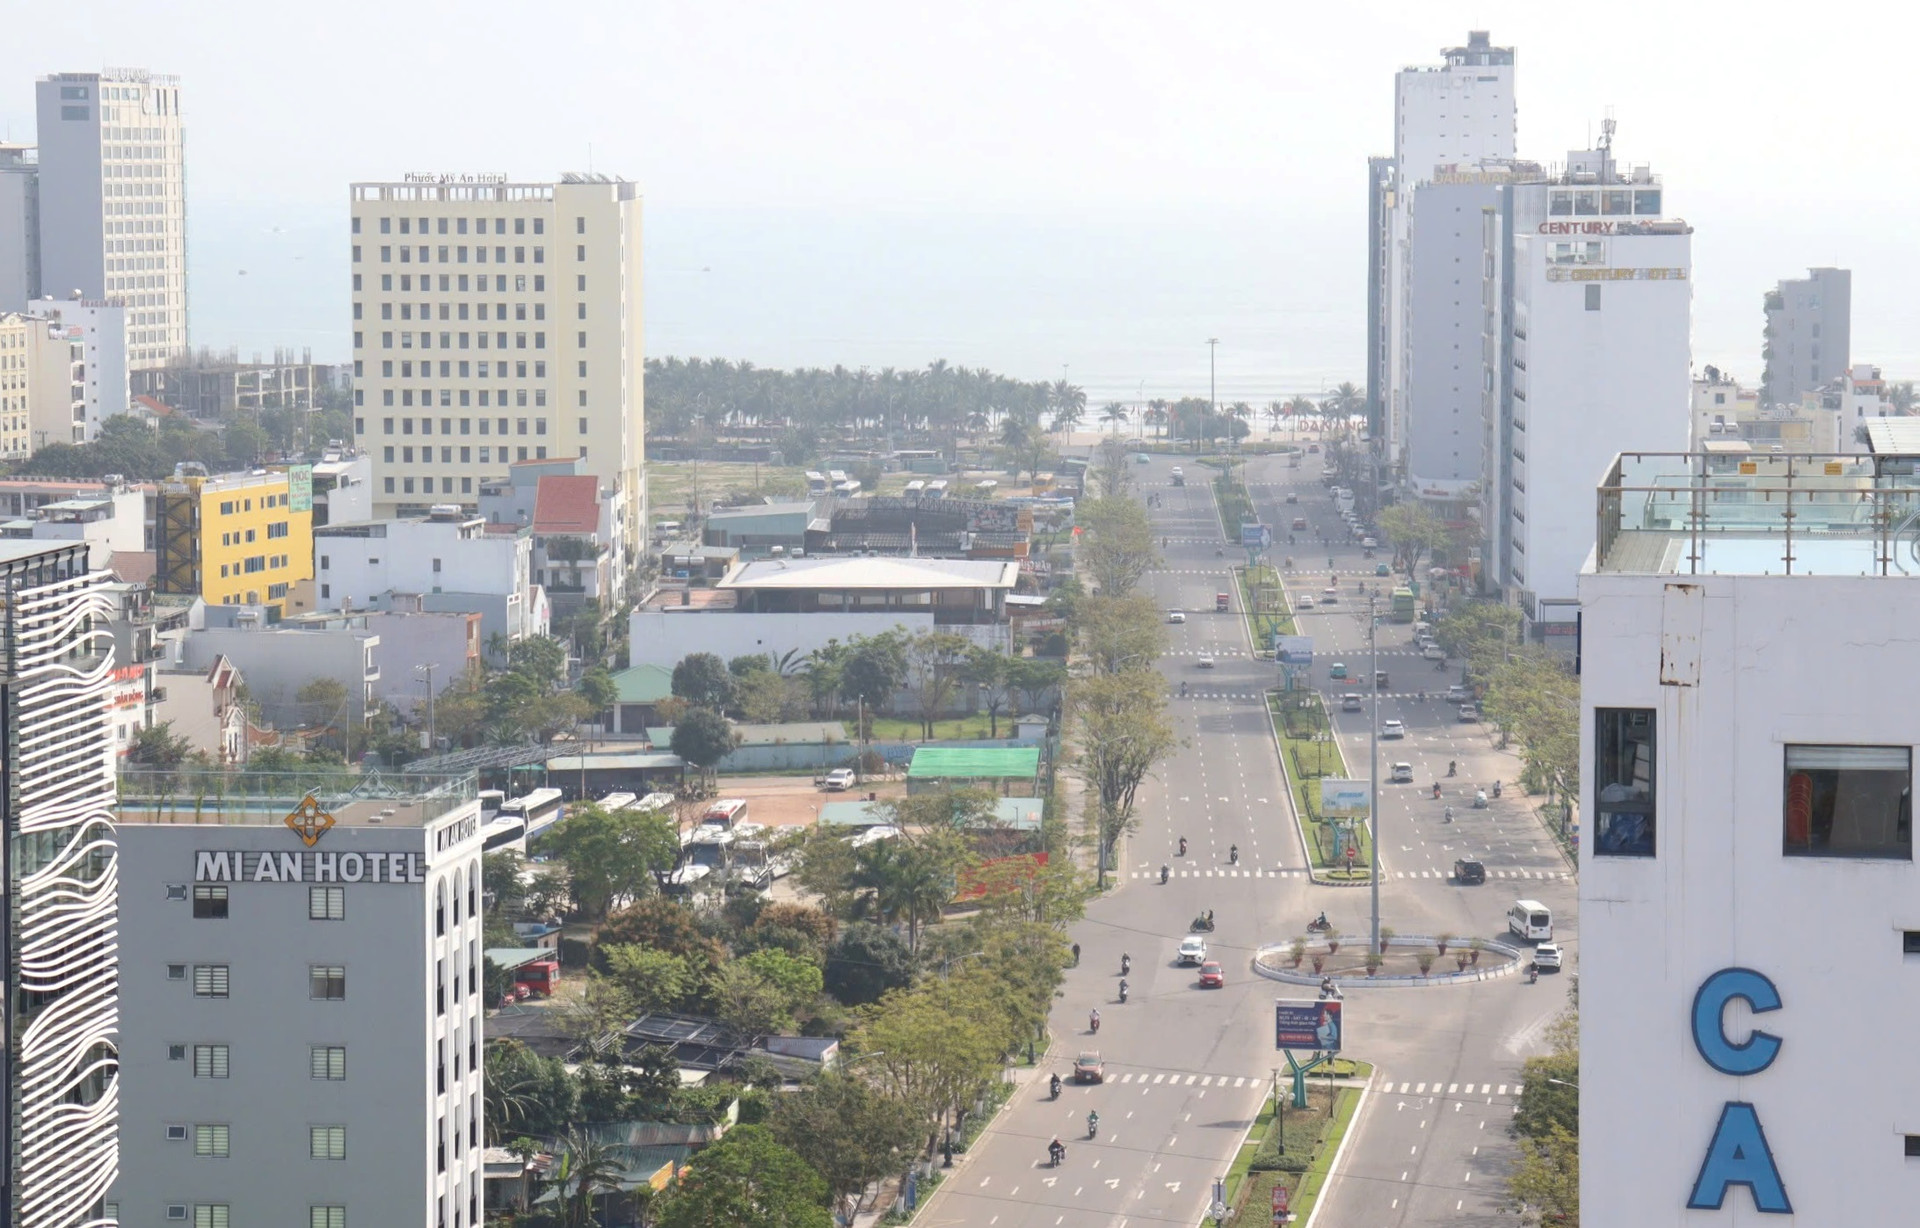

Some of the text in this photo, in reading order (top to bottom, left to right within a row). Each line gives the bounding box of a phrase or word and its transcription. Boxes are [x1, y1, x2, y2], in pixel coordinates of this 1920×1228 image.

[1538, 221, 1614, 235] CENTURY
[195, 851, 425, 883] MI AN HOTEL
